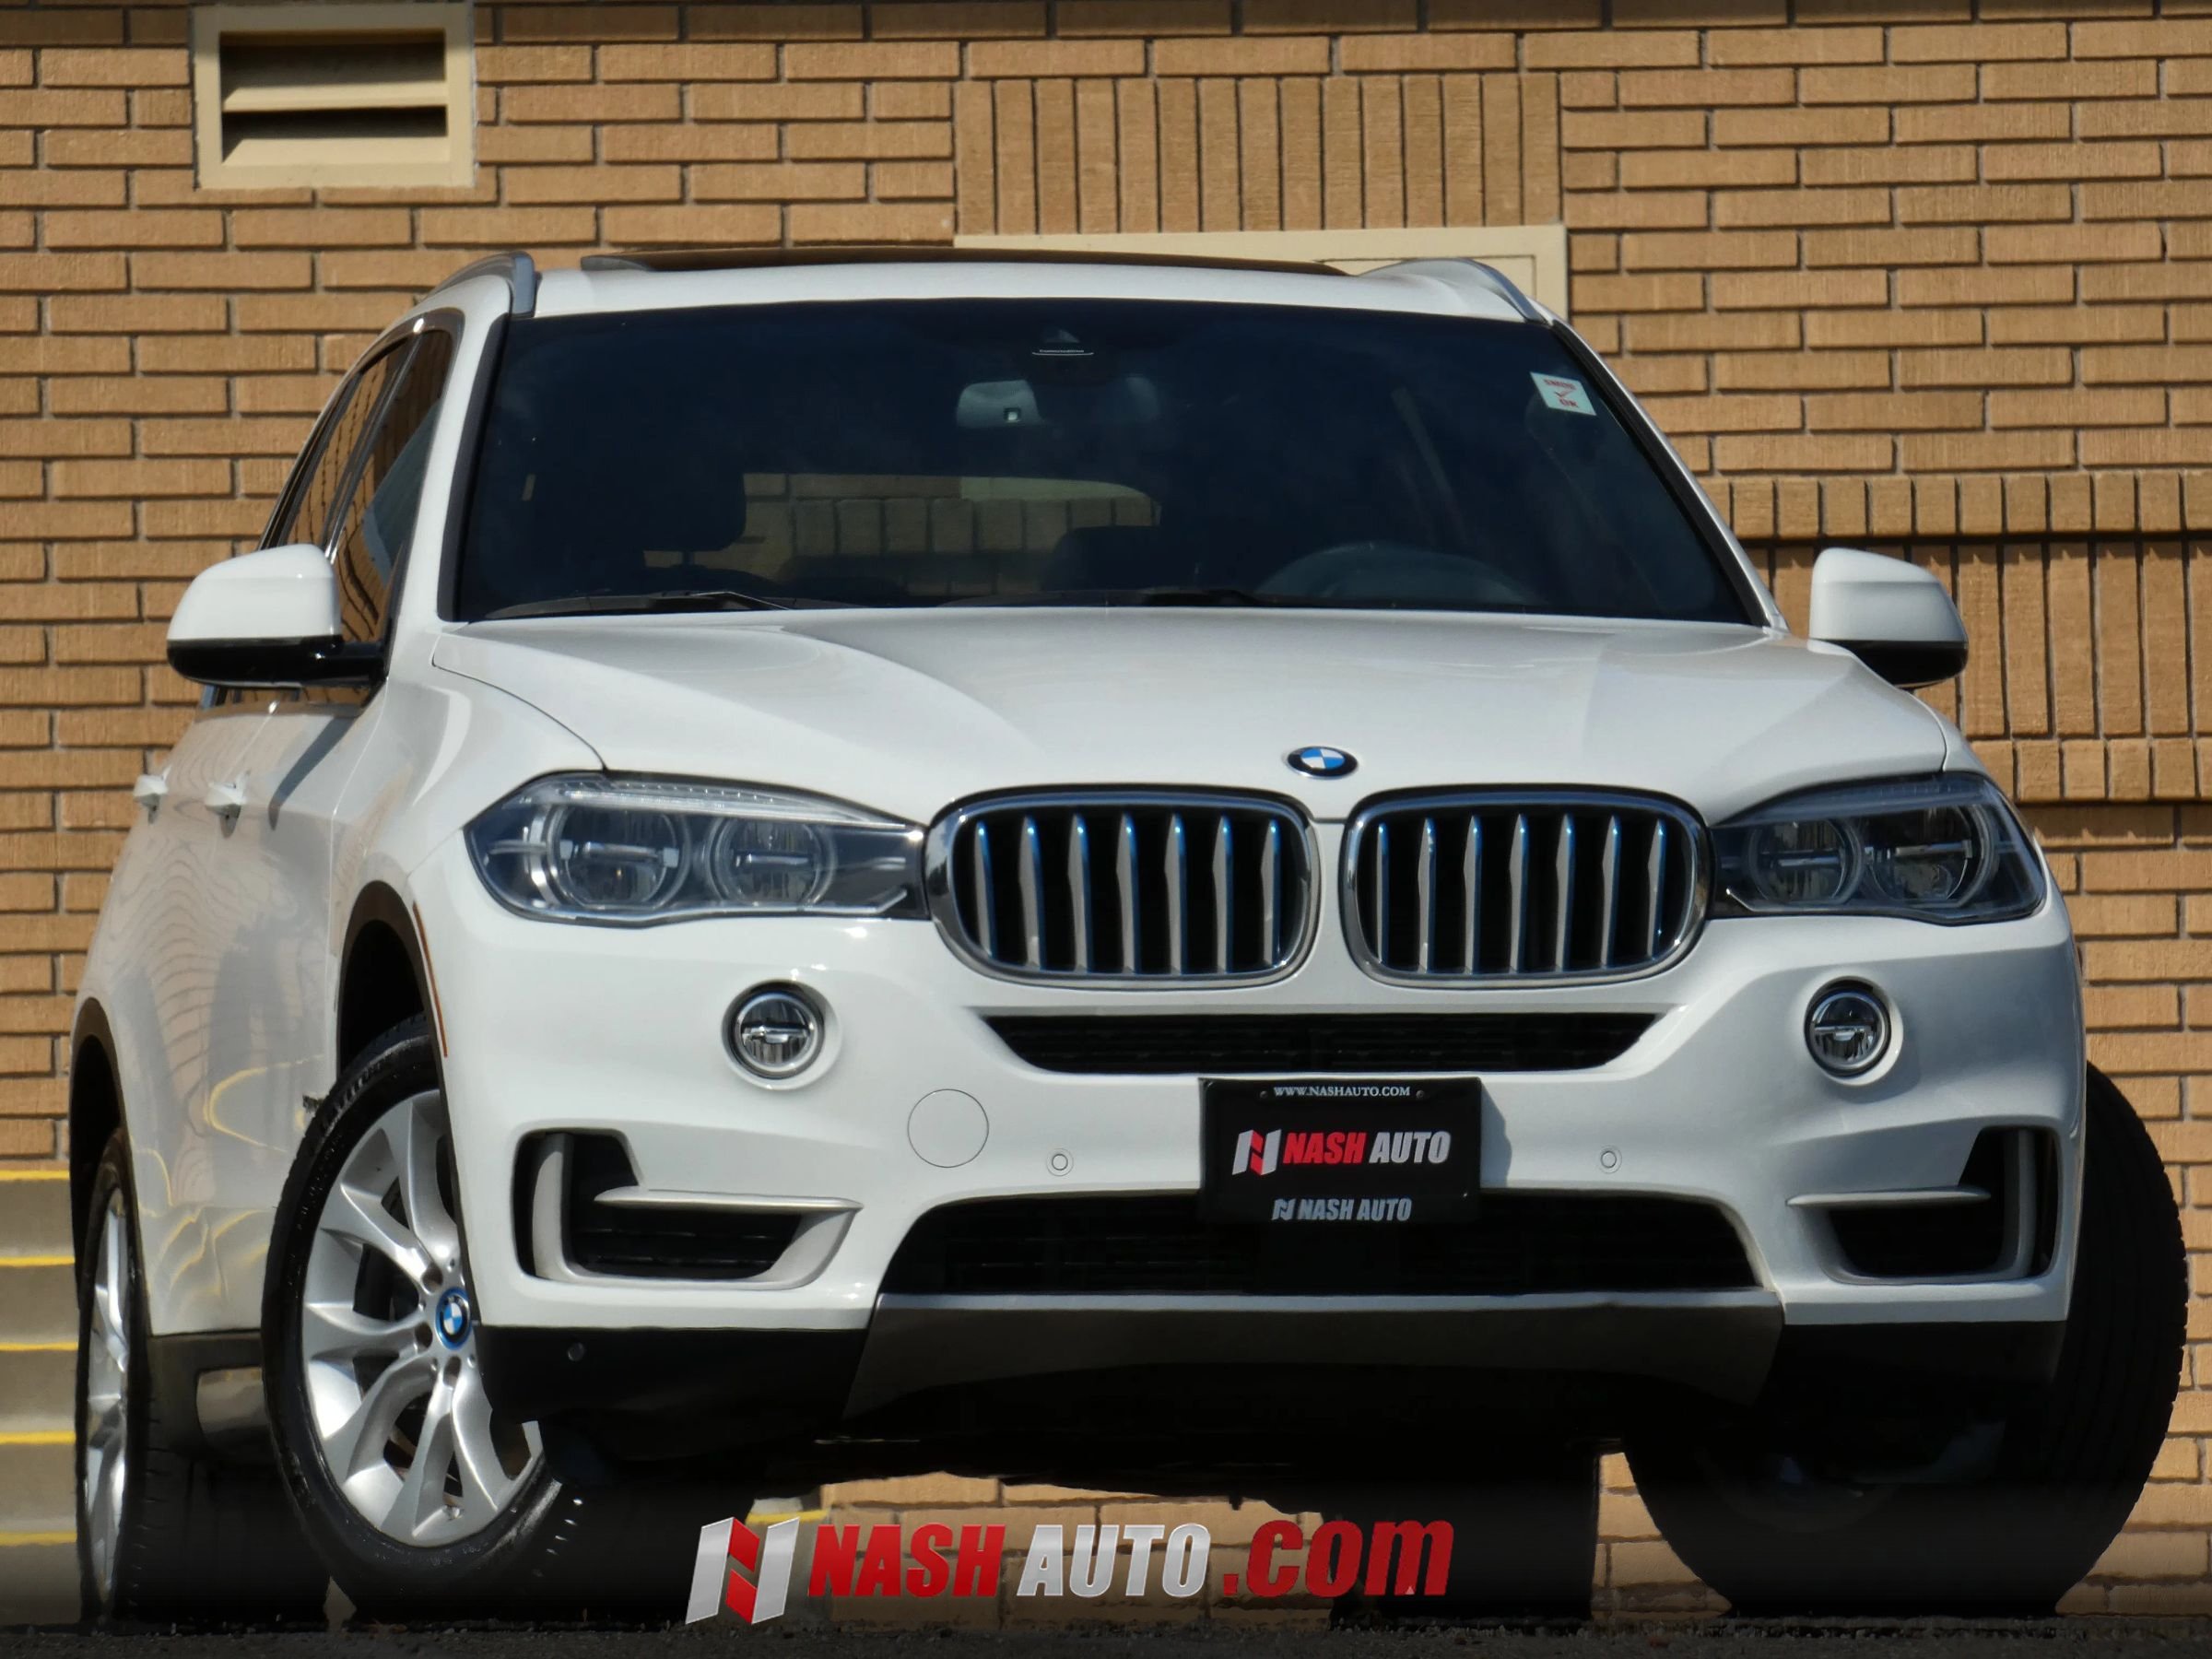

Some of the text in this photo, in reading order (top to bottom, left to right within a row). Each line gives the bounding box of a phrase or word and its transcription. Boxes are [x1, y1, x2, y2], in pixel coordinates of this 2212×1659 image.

[1274, 1086, 1410, 1097] WWW.NASHAUTO.COM
[1283, 1132, 1367, 1164] NASH
[1369, 1131, 1451, 1164] AUTO
[1298, 1198, 1354, 1220] NASH
[1357, 1198, 1412, 1221] AUTO
